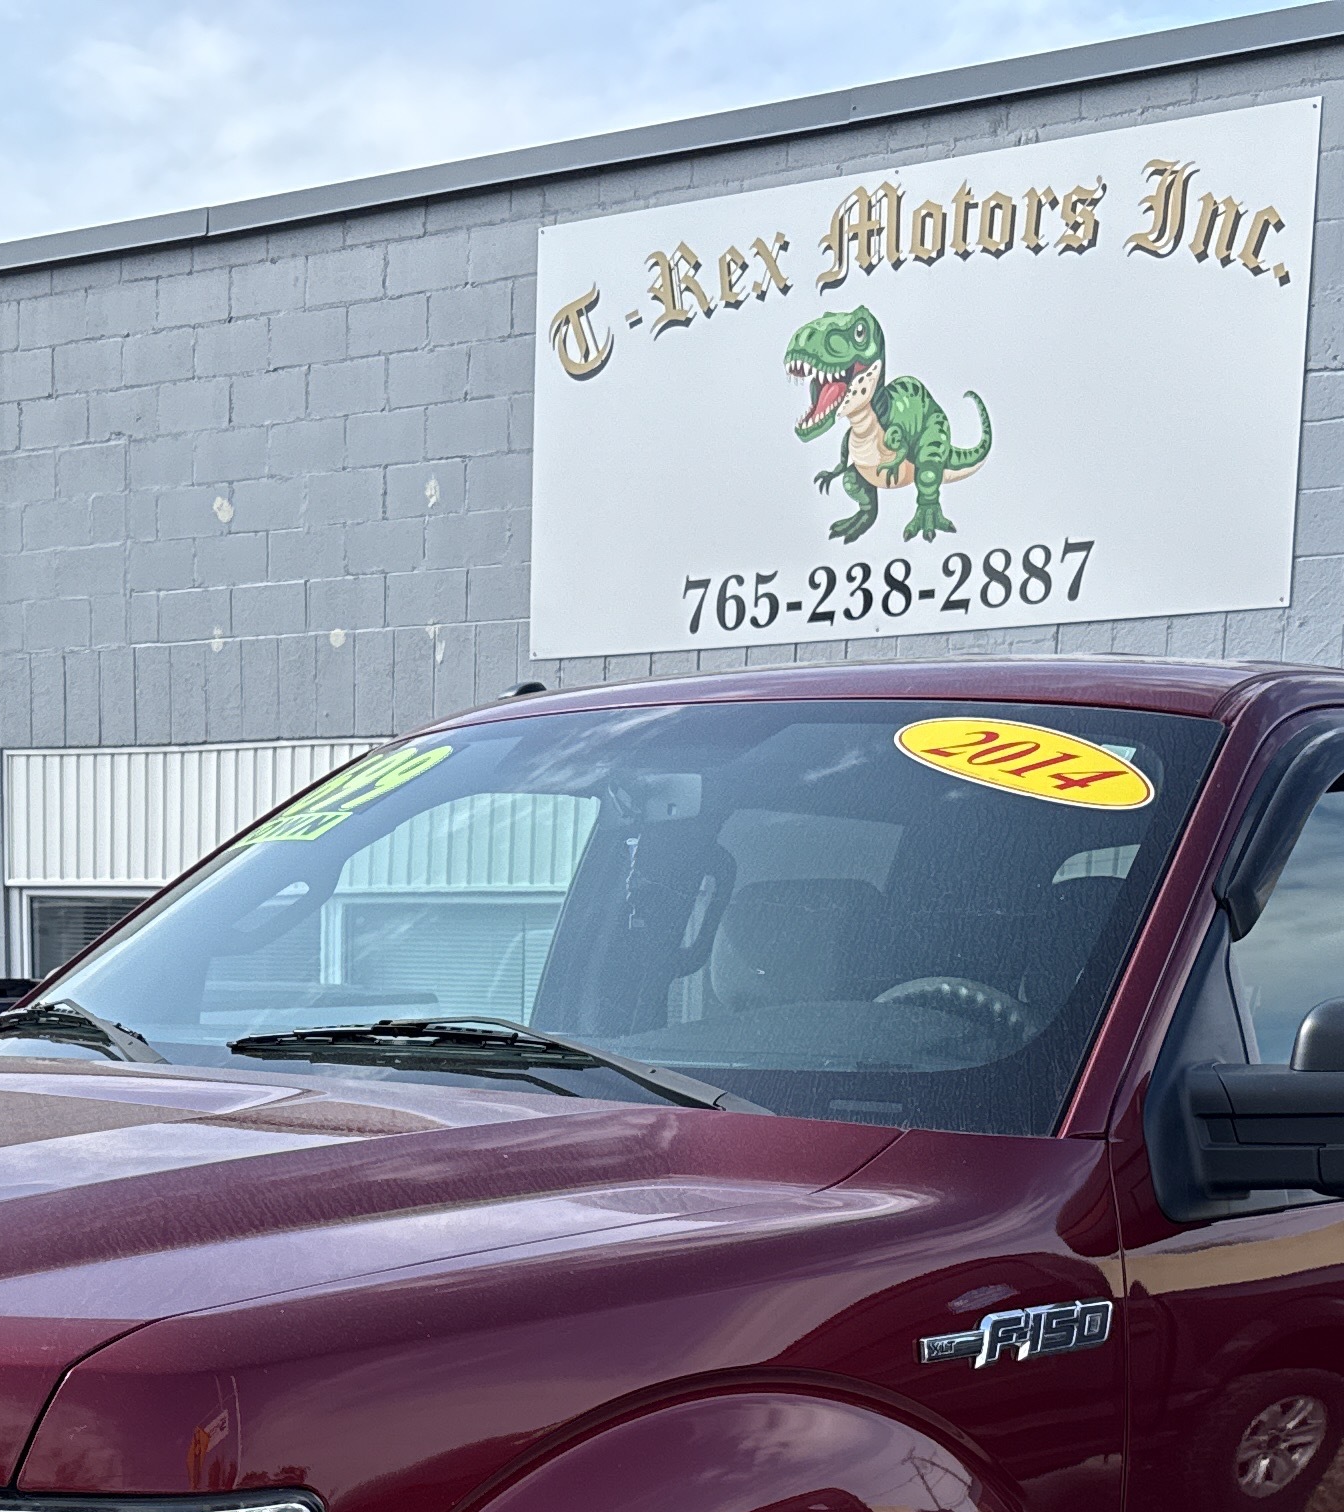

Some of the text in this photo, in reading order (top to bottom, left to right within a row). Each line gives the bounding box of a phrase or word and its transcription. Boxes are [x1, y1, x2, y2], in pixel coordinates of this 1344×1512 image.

[549, 159, 1290, 382] T-Rex Motors Inc.
[682, 537, 1095, 635] 765-238-2887
[920, 731, 1129, 790] 2014
[241, 814, 345, 843] OWN
